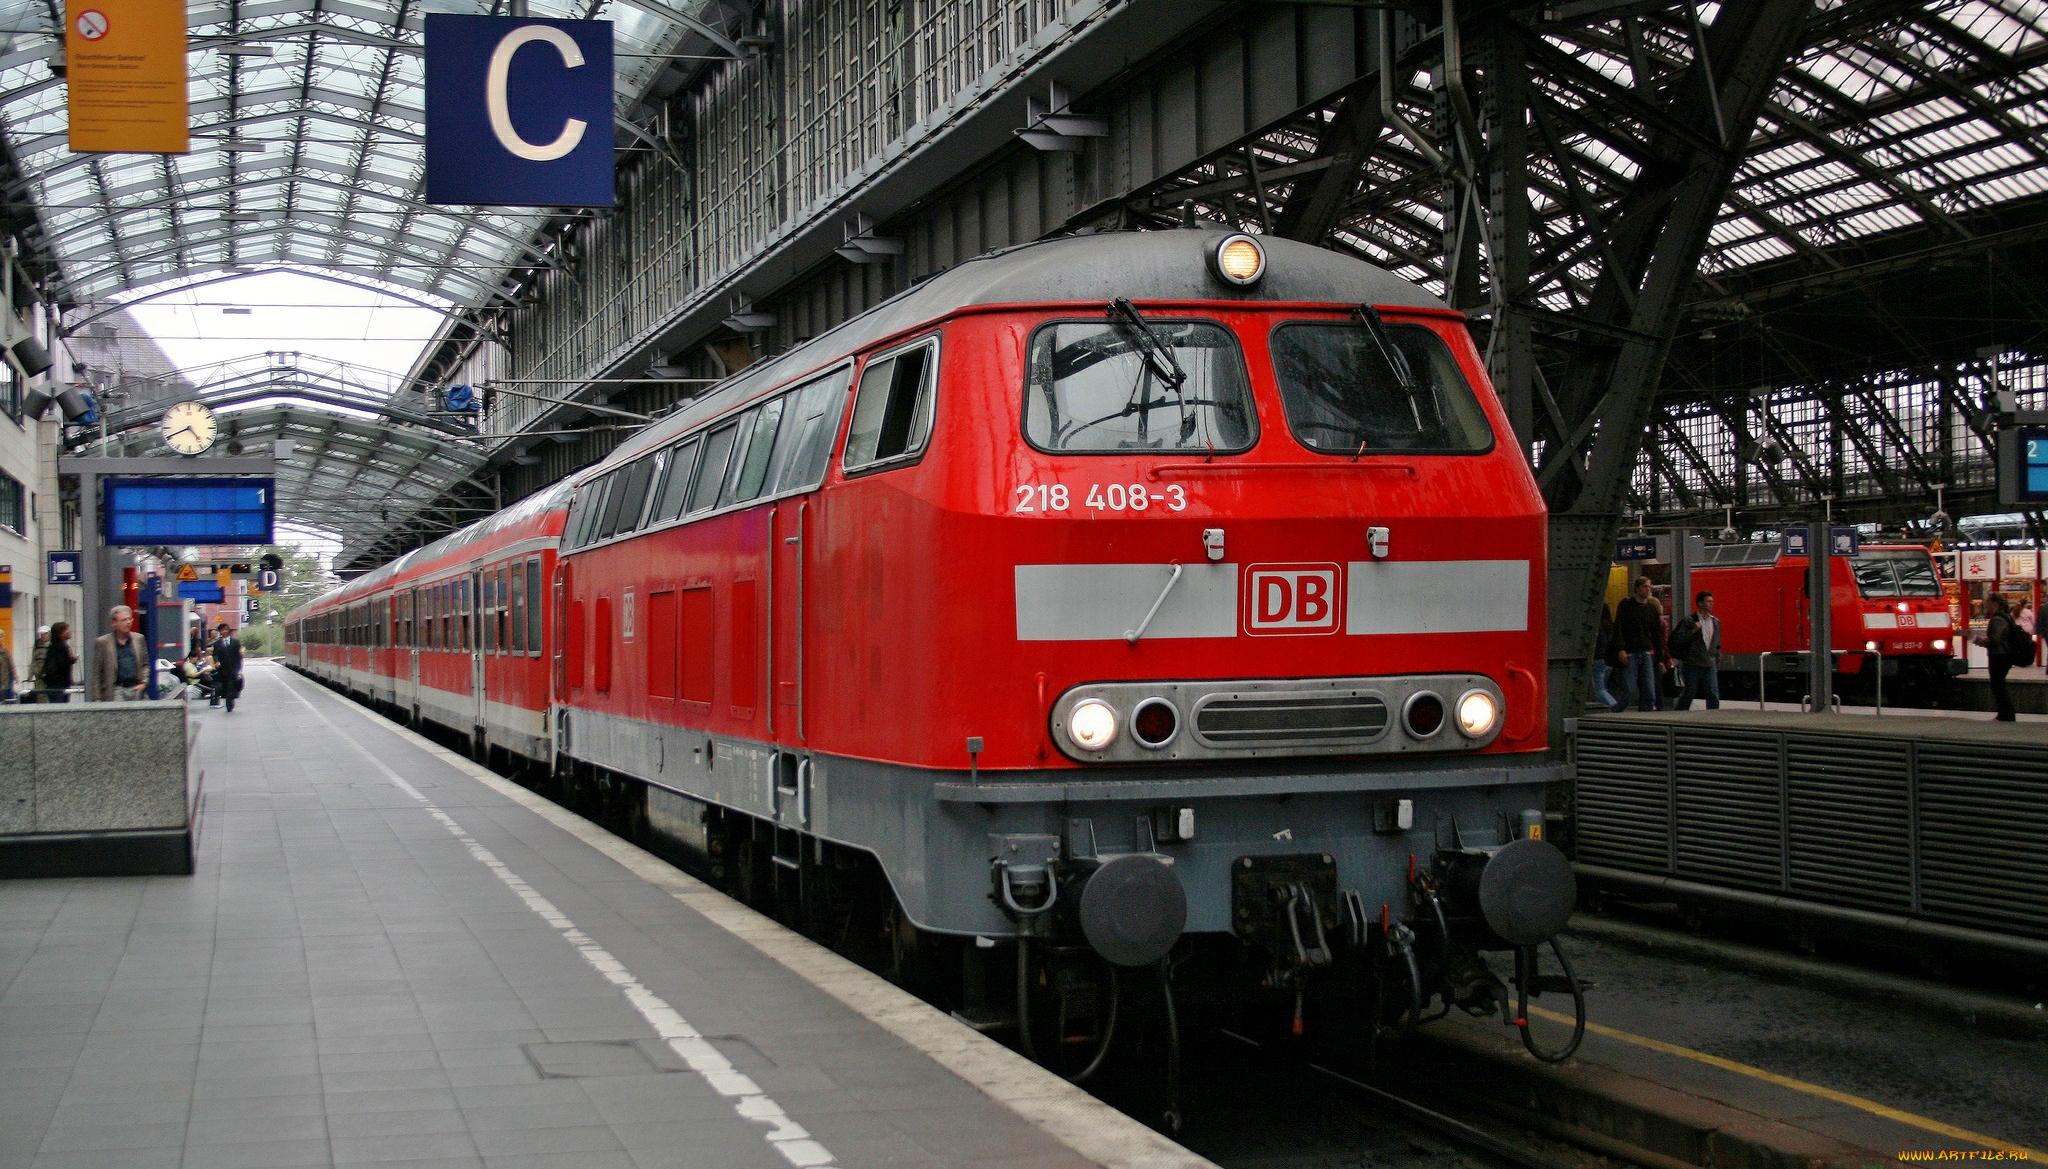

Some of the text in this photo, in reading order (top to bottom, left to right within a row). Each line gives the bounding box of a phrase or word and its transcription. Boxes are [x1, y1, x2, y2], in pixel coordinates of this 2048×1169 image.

[487, 24, 588, 161] C
[2027, 440, 2038, 457] 2
[256, 488, 265, 504] 1
[1015, 483, 1188, 512] 218 408-3
[264, 570, 277, 587] D
[251, 599, 259, 610] E
[1257, 574, 1329, 622] DB
[1900, 616, 1914, 626] DB
